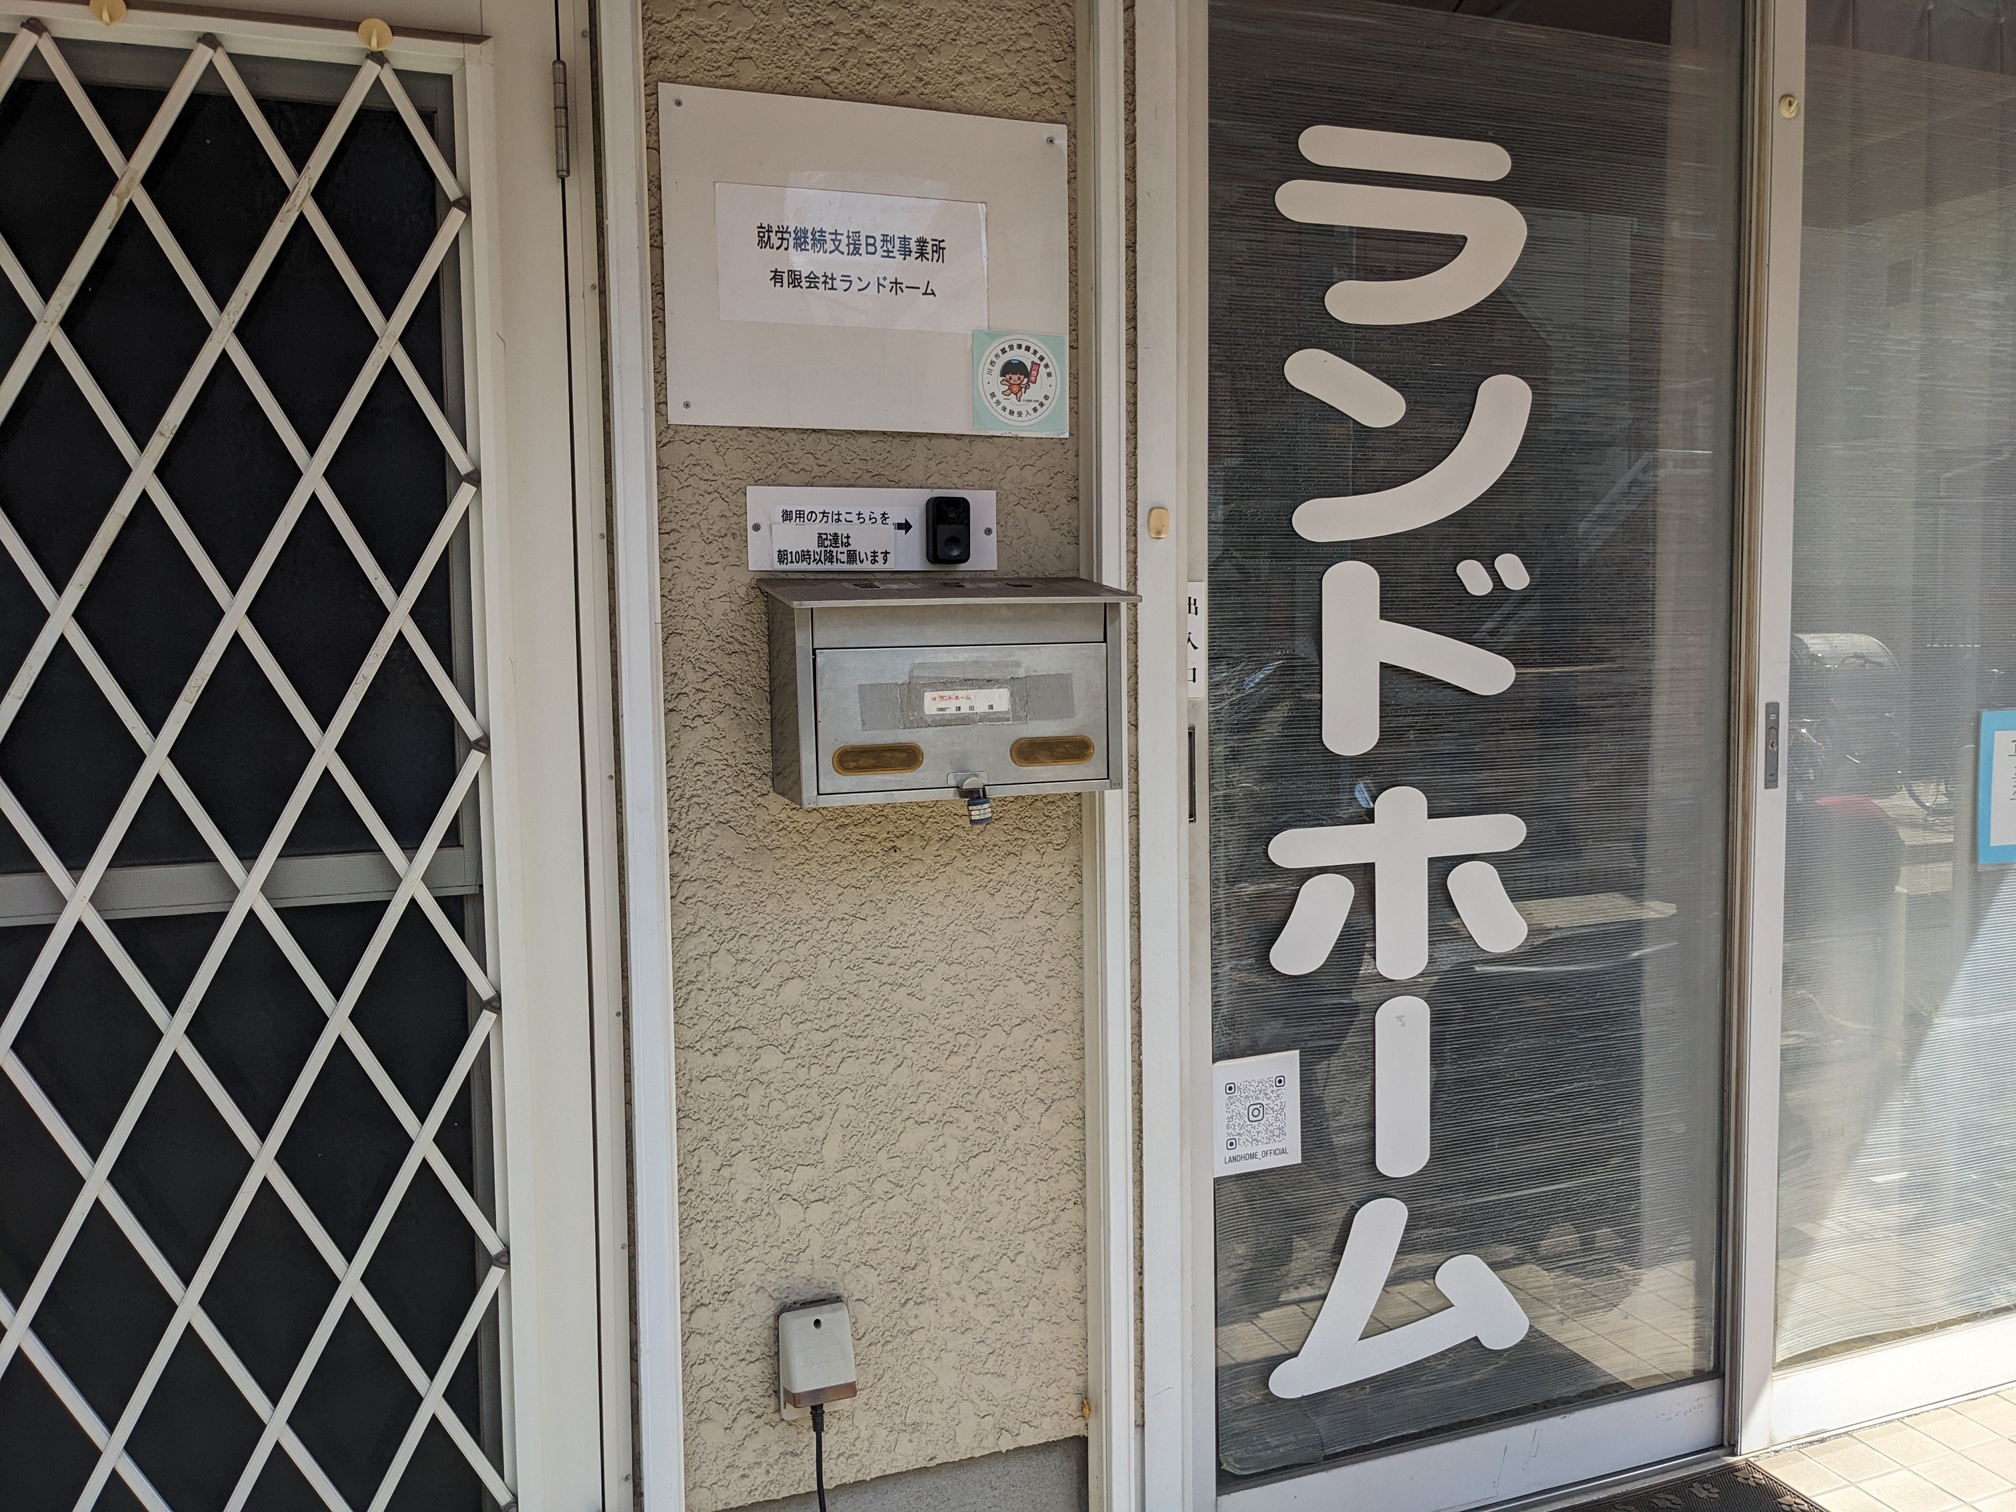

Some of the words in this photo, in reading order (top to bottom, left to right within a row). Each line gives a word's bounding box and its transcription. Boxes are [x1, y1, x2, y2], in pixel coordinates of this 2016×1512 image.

[769, 267, 937, 298] 有限会社ランドホーム
[781, 509, 890, 525] 御用の方はこちらを
[817, 532, 851, 548] 配達は
[776, 549, 891, 566] 朝10時以降に願います
[1268, 125, 1532, 1399] ランドホーム
[1224, 1147, 1288, 1164] LANDHOME_OFFICIAL
